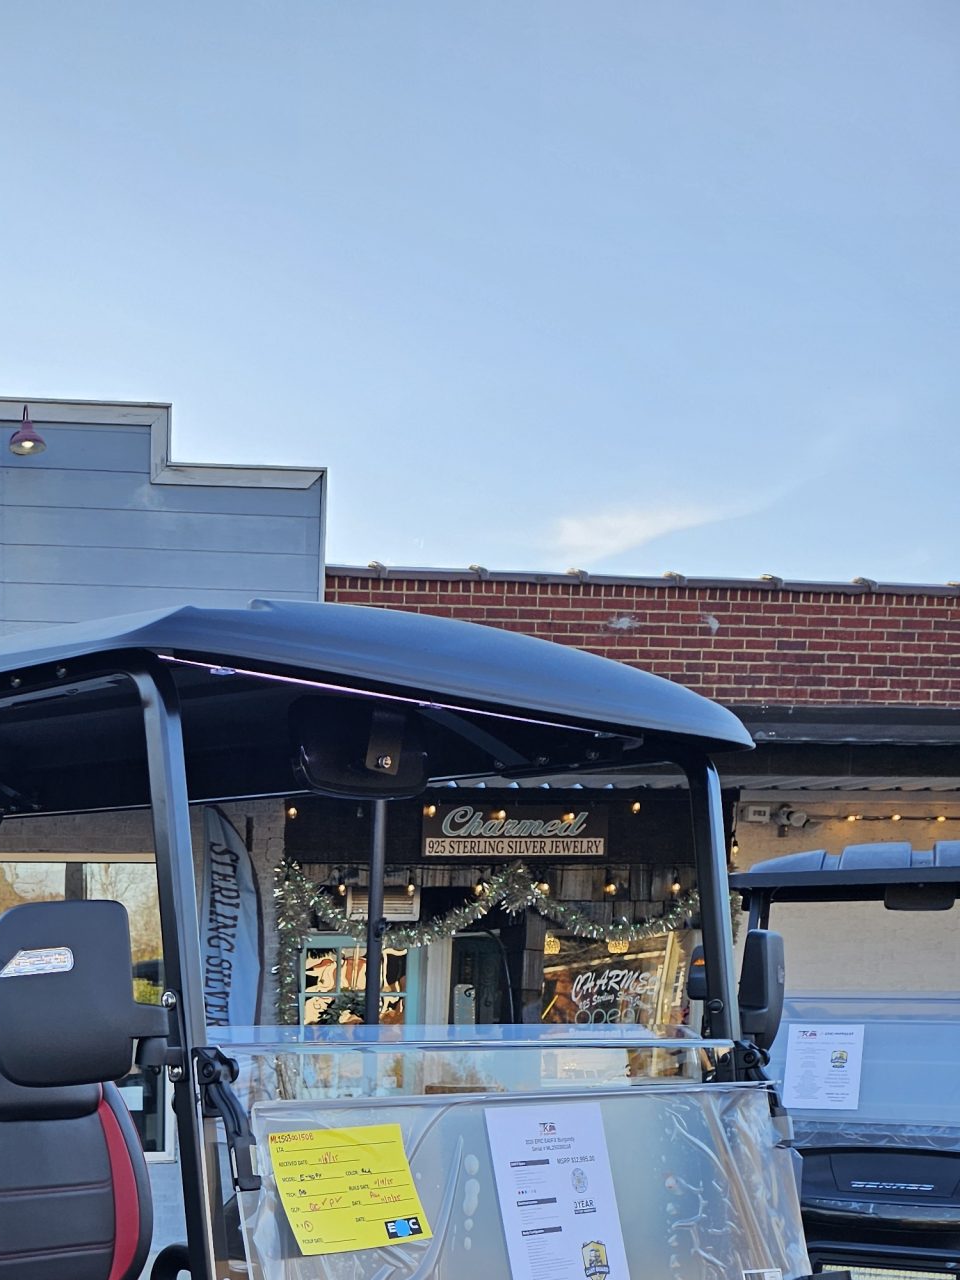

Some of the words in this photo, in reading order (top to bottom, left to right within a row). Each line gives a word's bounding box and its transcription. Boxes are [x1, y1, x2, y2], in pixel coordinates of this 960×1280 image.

[441, 805, 589, 837] Charmed
[428, 840, 446, 855] 925
[448, 840, 505, 855] STERLING
[507, 841, 547, 855] SILVER
[548, 840, 603, 855] JEWELRY
[206, 841, 240, 953] STERLING
[204, 955, 233, 1027] SILVER
[387, 1217, 419, 1234] EC
